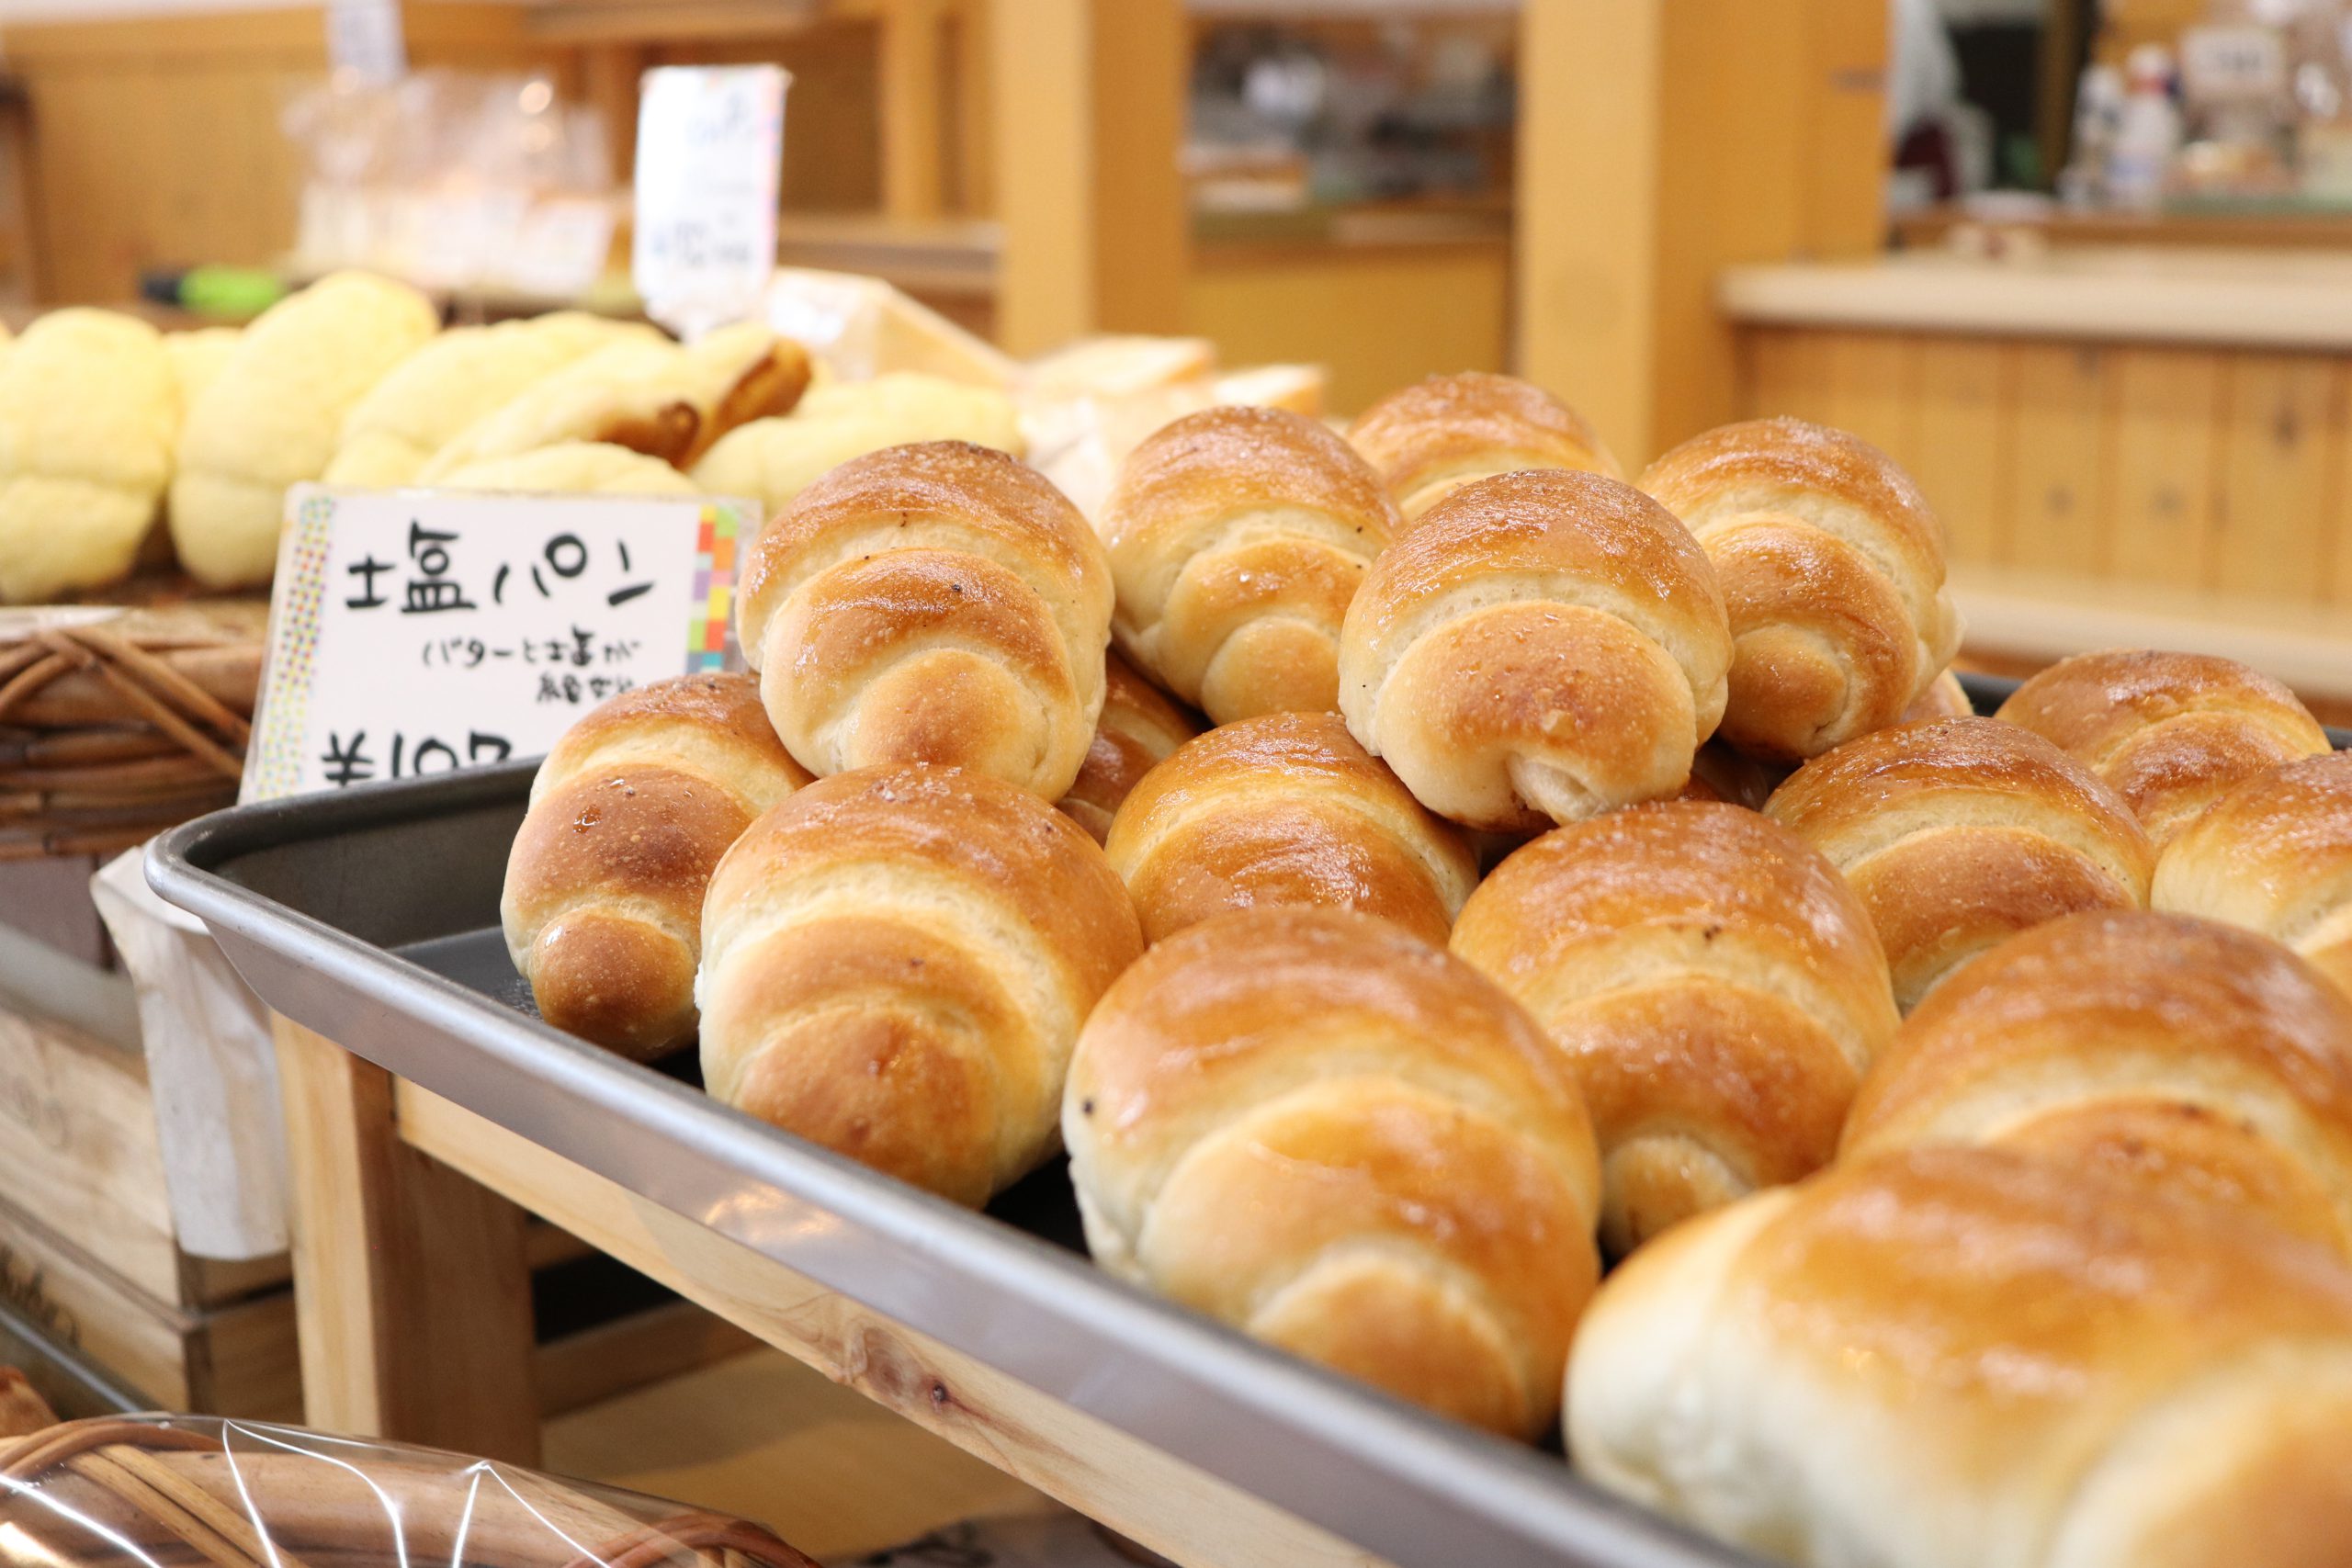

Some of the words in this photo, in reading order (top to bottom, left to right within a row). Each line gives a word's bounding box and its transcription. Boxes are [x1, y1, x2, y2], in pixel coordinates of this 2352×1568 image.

[345, 519, 653, 614] 塩パン
[423, 625, 640, 668] バターと塩が
